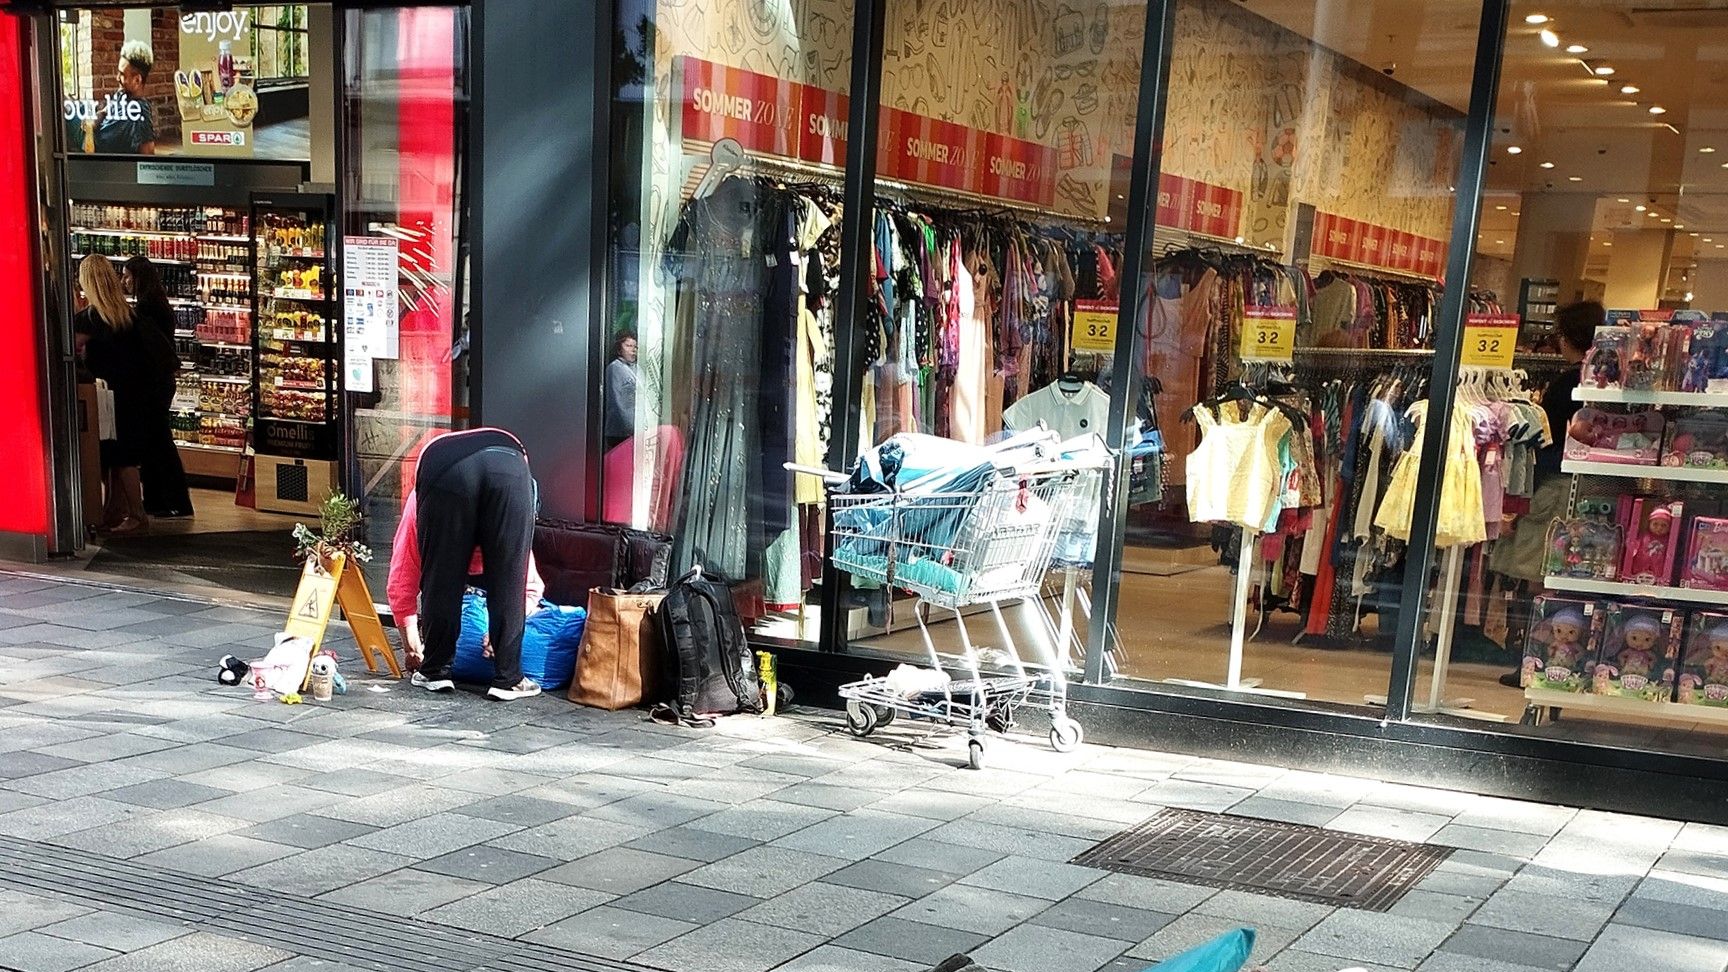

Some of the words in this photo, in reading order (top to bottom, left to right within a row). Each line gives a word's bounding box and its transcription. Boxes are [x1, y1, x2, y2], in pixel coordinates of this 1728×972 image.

[104, 93, 145, 122] life.
[693, 87, 753, 121] SOMMER
[754, 100, 795, 131] ZONE
[198, 133, 232, 143] SPAR
[906, 137, 949, 164] SOMMER
[989, 155, 1027, 181] SOMMER
